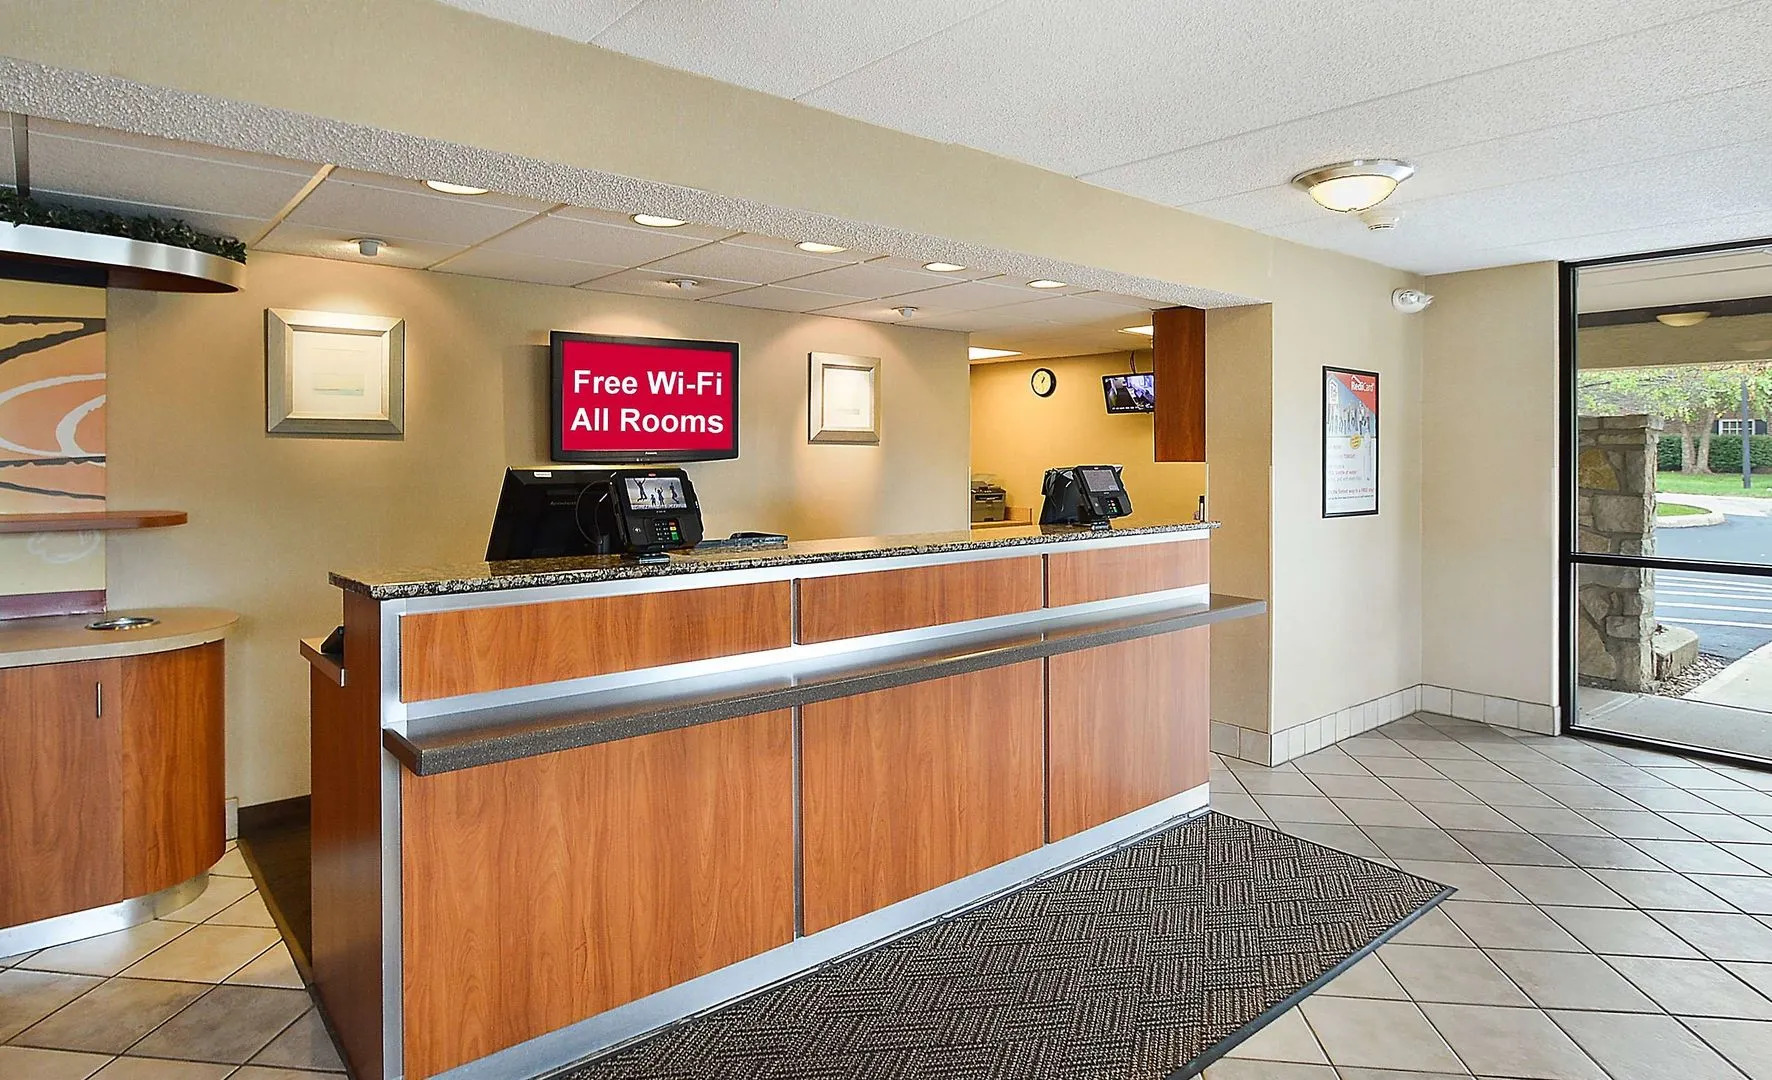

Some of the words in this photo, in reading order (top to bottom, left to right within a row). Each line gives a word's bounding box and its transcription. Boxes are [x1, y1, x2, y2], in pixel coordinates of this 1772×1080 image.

[573, 369, 639, 395] Free
[646, 371, 723, 396] Wi-Fi
[570, 407, 609, 432] All
[620, 407, 724, 434] Rooms
